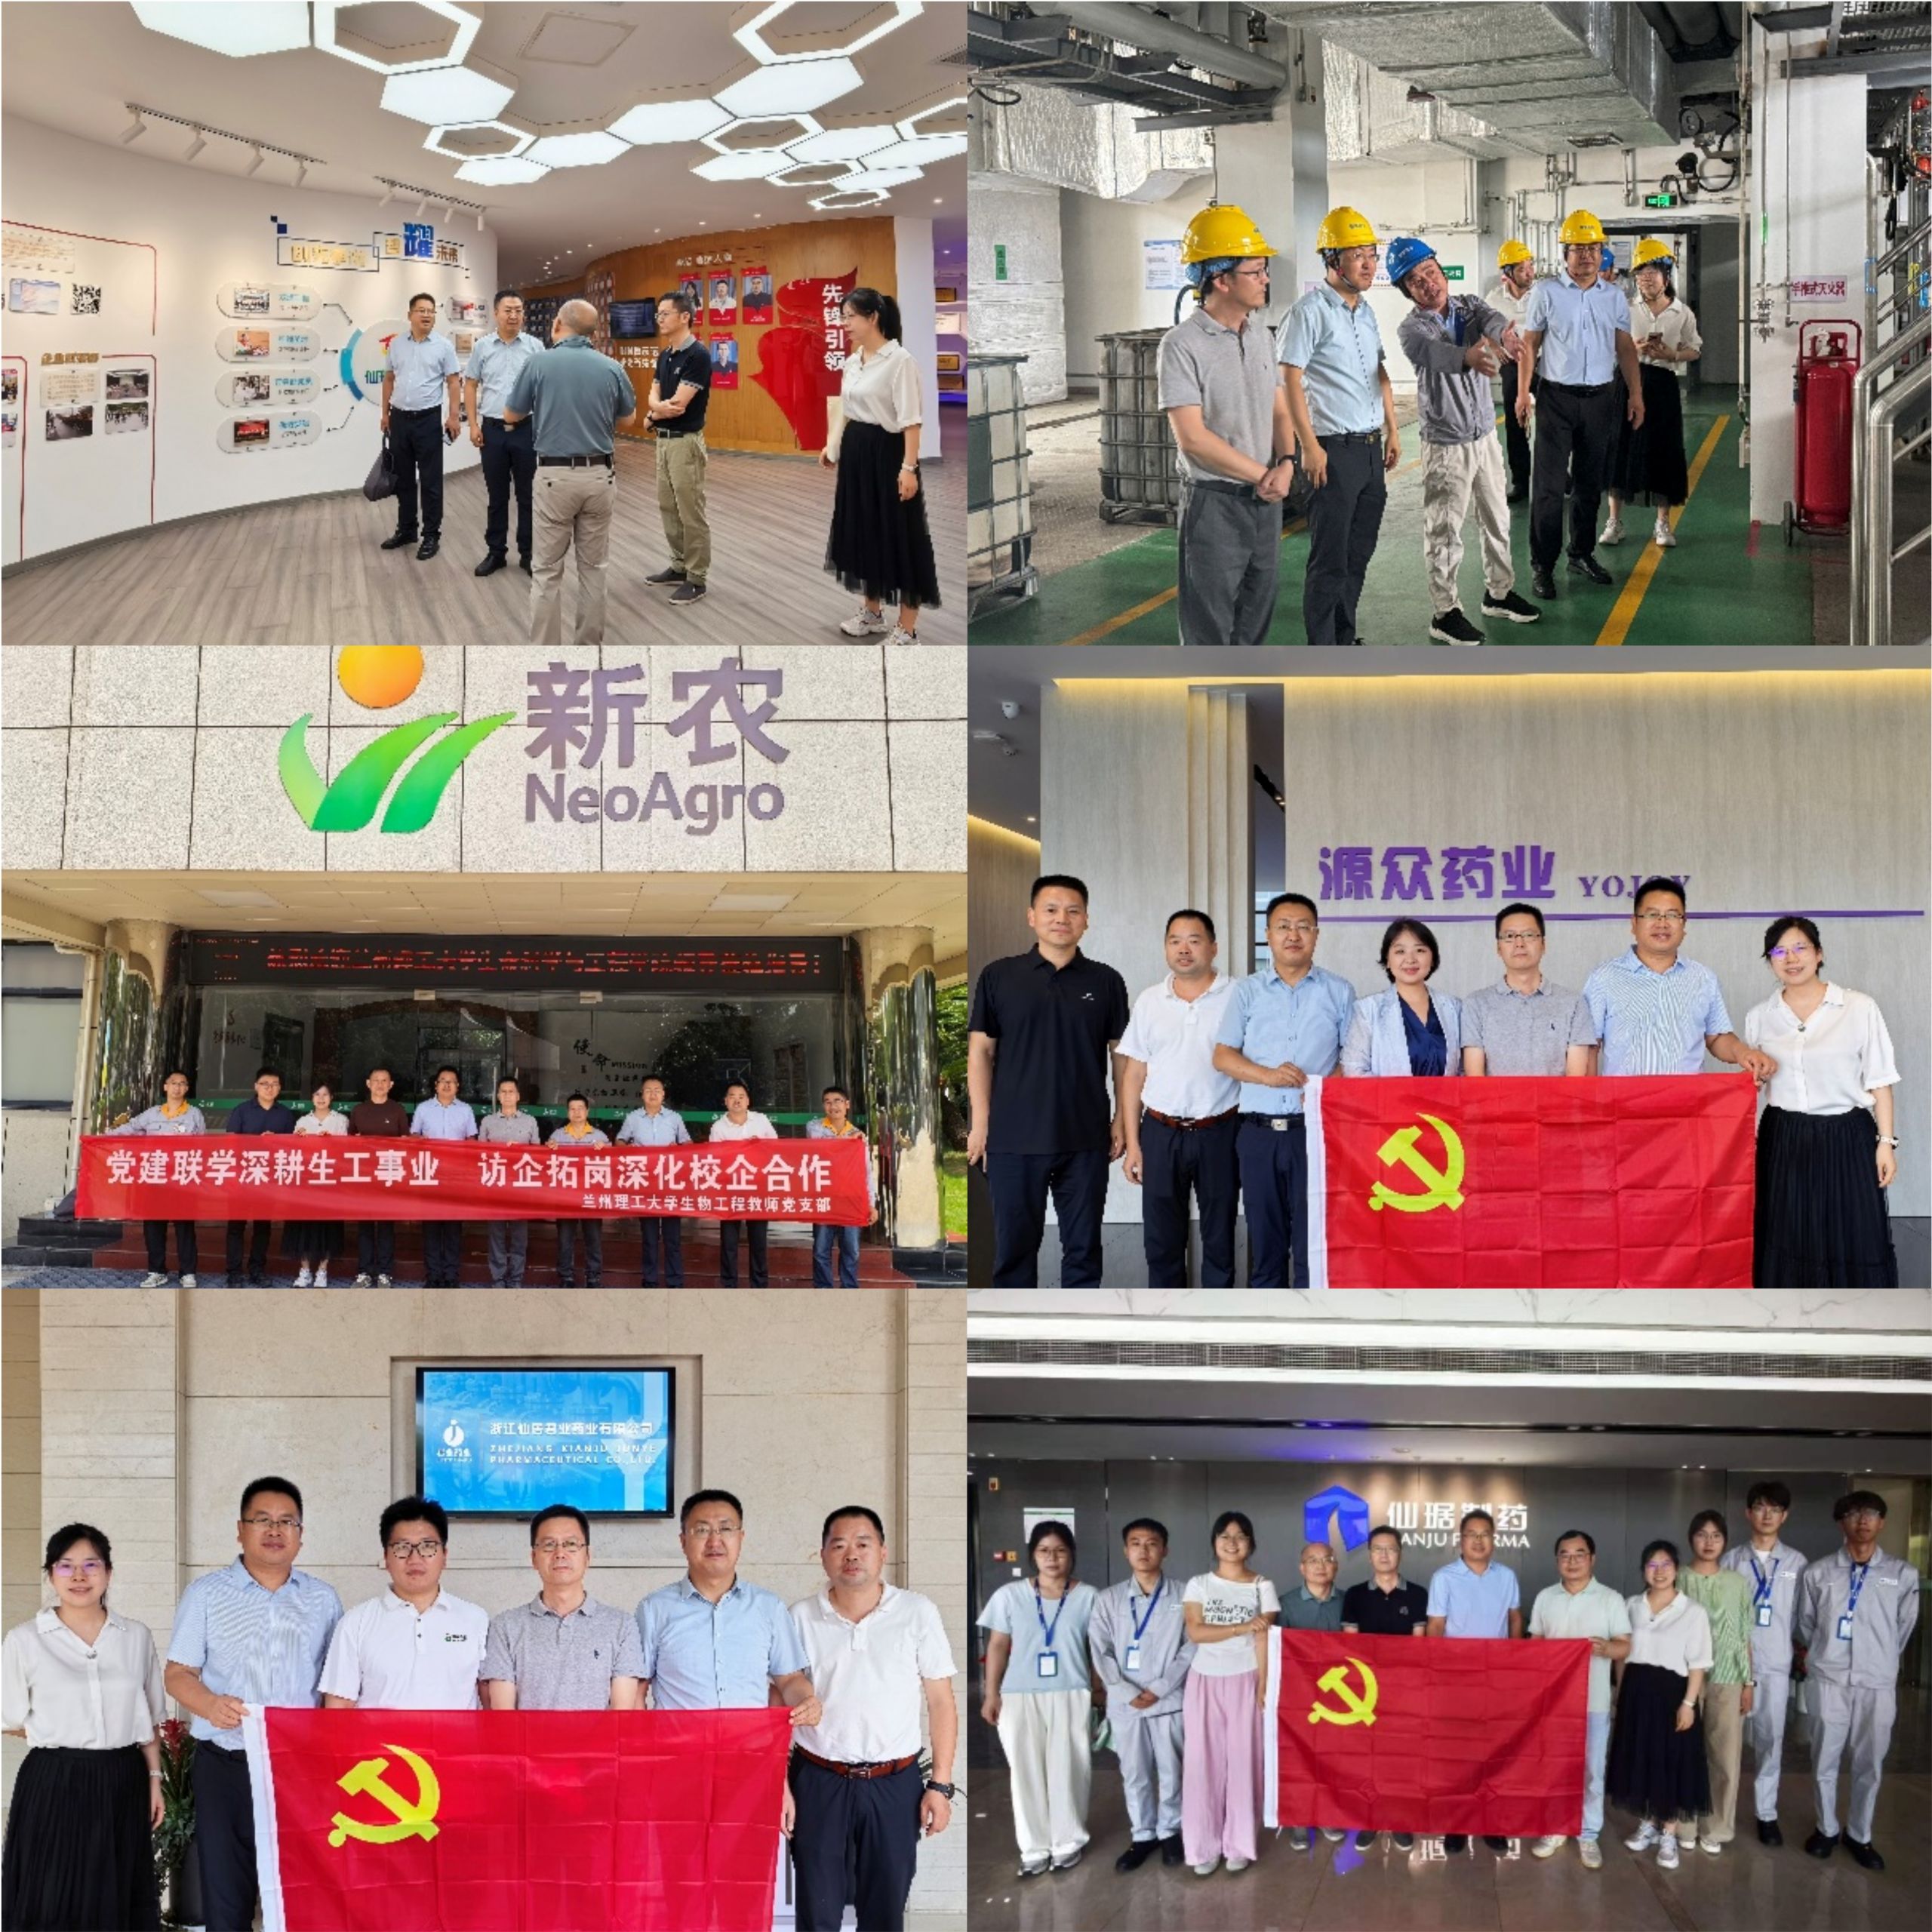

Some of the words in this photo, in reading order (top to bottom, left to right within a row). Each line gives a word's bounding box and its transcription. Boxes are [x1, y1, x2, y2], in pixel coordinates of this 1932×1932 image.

[525, 657, 790, 769] 新农
[526, 772, 785, 835] NeoAgro
[1318, 844, 1556, 900] 源众药业
[106, 1149, 439, 1187] 党建联学深耕生工事业
[478, 1151, 832, 1192] 访企拓岗深化校企合作
[582, 1194, 832, 1213] 兰州理工大学生物工程教师党支部
[1401, 1533, 1447, 1548] ANJU
